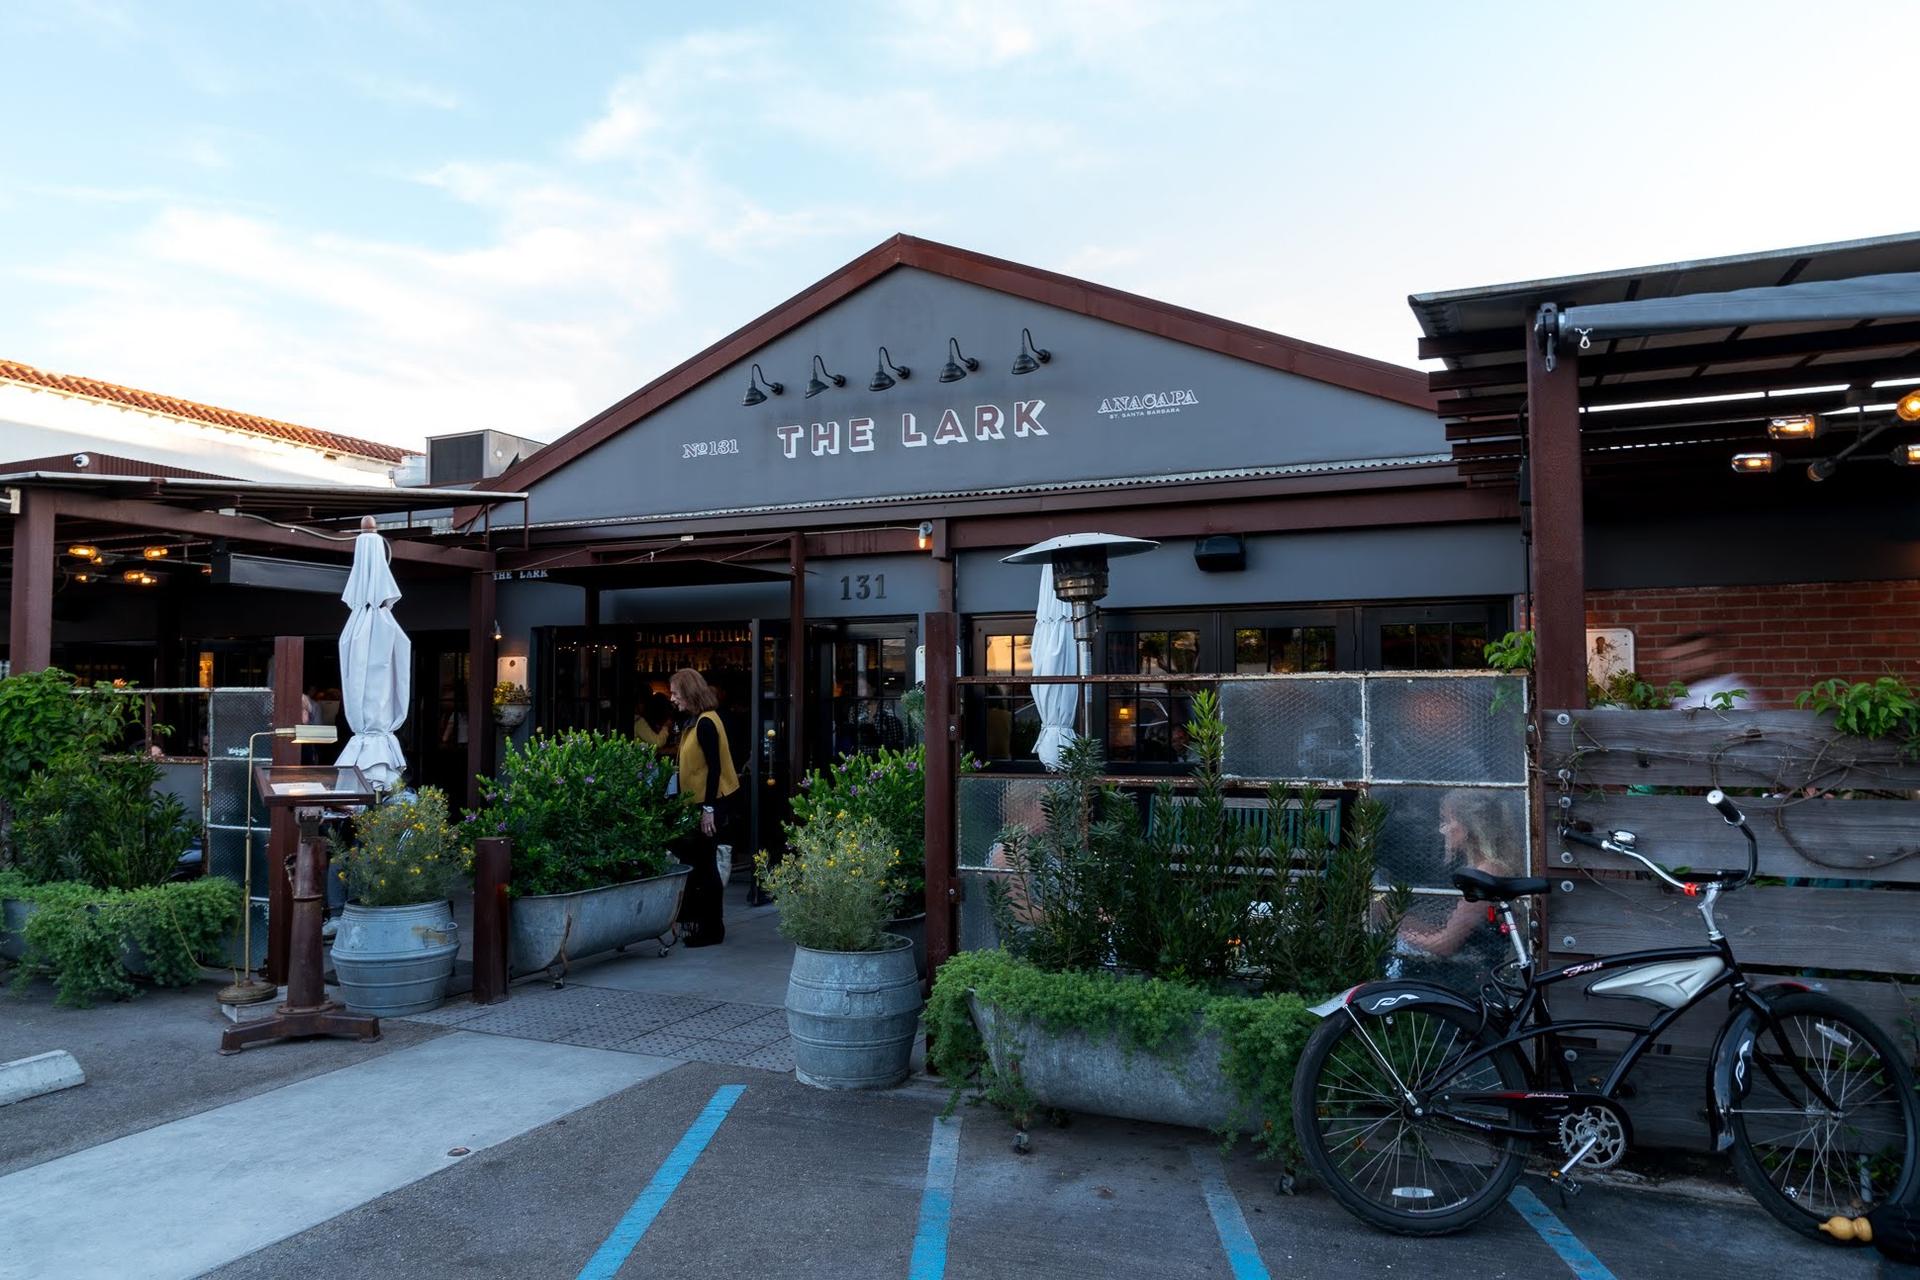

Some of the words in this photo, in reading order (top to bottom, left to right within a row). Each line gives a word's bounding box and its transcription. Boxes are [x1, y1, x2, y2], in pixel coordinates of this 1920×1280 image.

[1097, 389, 1199, 413] ANACAPA
[1146, 407, 1180, 415] BARBARA
[777, 417, 874, 458] THE
[902, 399, 1049, 448] LARK
[492, 571, 512, 580] THE
[520, 569, 549, 579] LARK
[840, 574, 887, 600] 131
